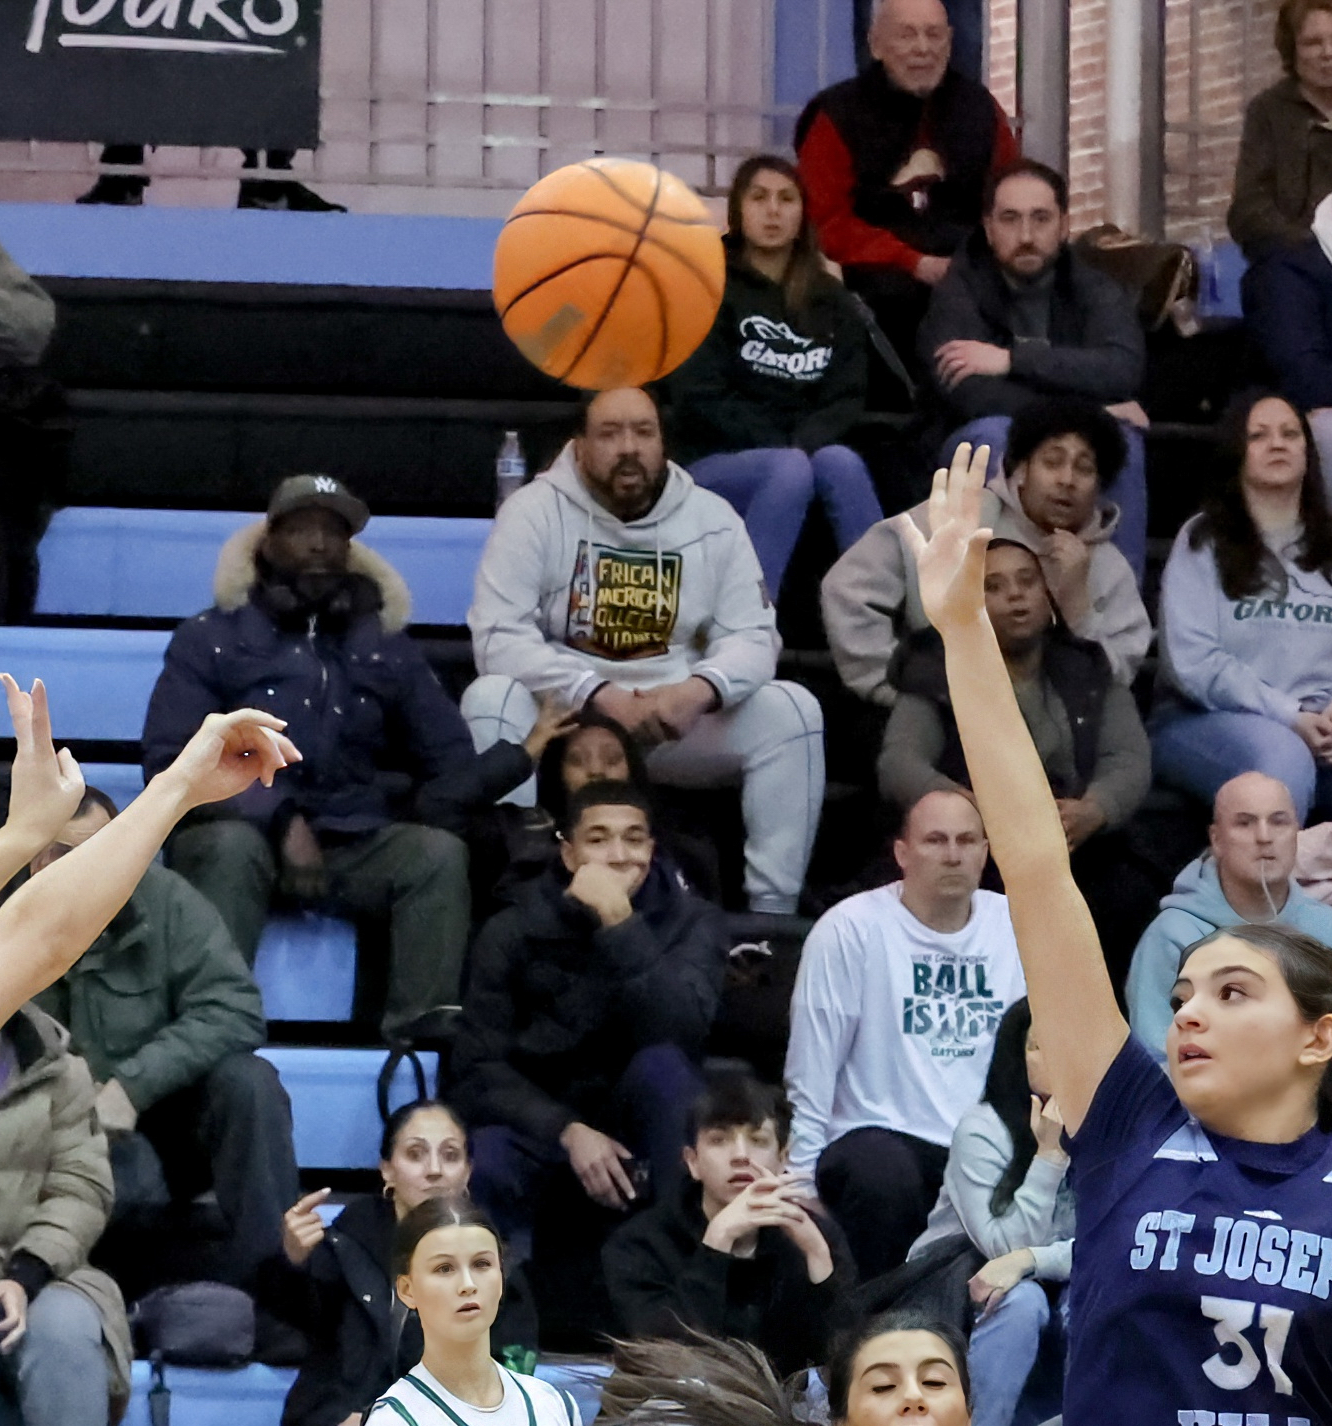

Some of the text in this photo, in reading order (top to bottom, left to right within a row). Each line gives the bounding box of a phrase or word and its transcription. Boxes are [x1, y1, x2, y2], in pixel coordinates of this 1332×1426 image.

[913, 963, 993, 999] BALL
[902, 997, 934, 1035] IS
[1130, 1210, 1196, 1270] ST
[1200, 1295, 1295, 1396] 31
